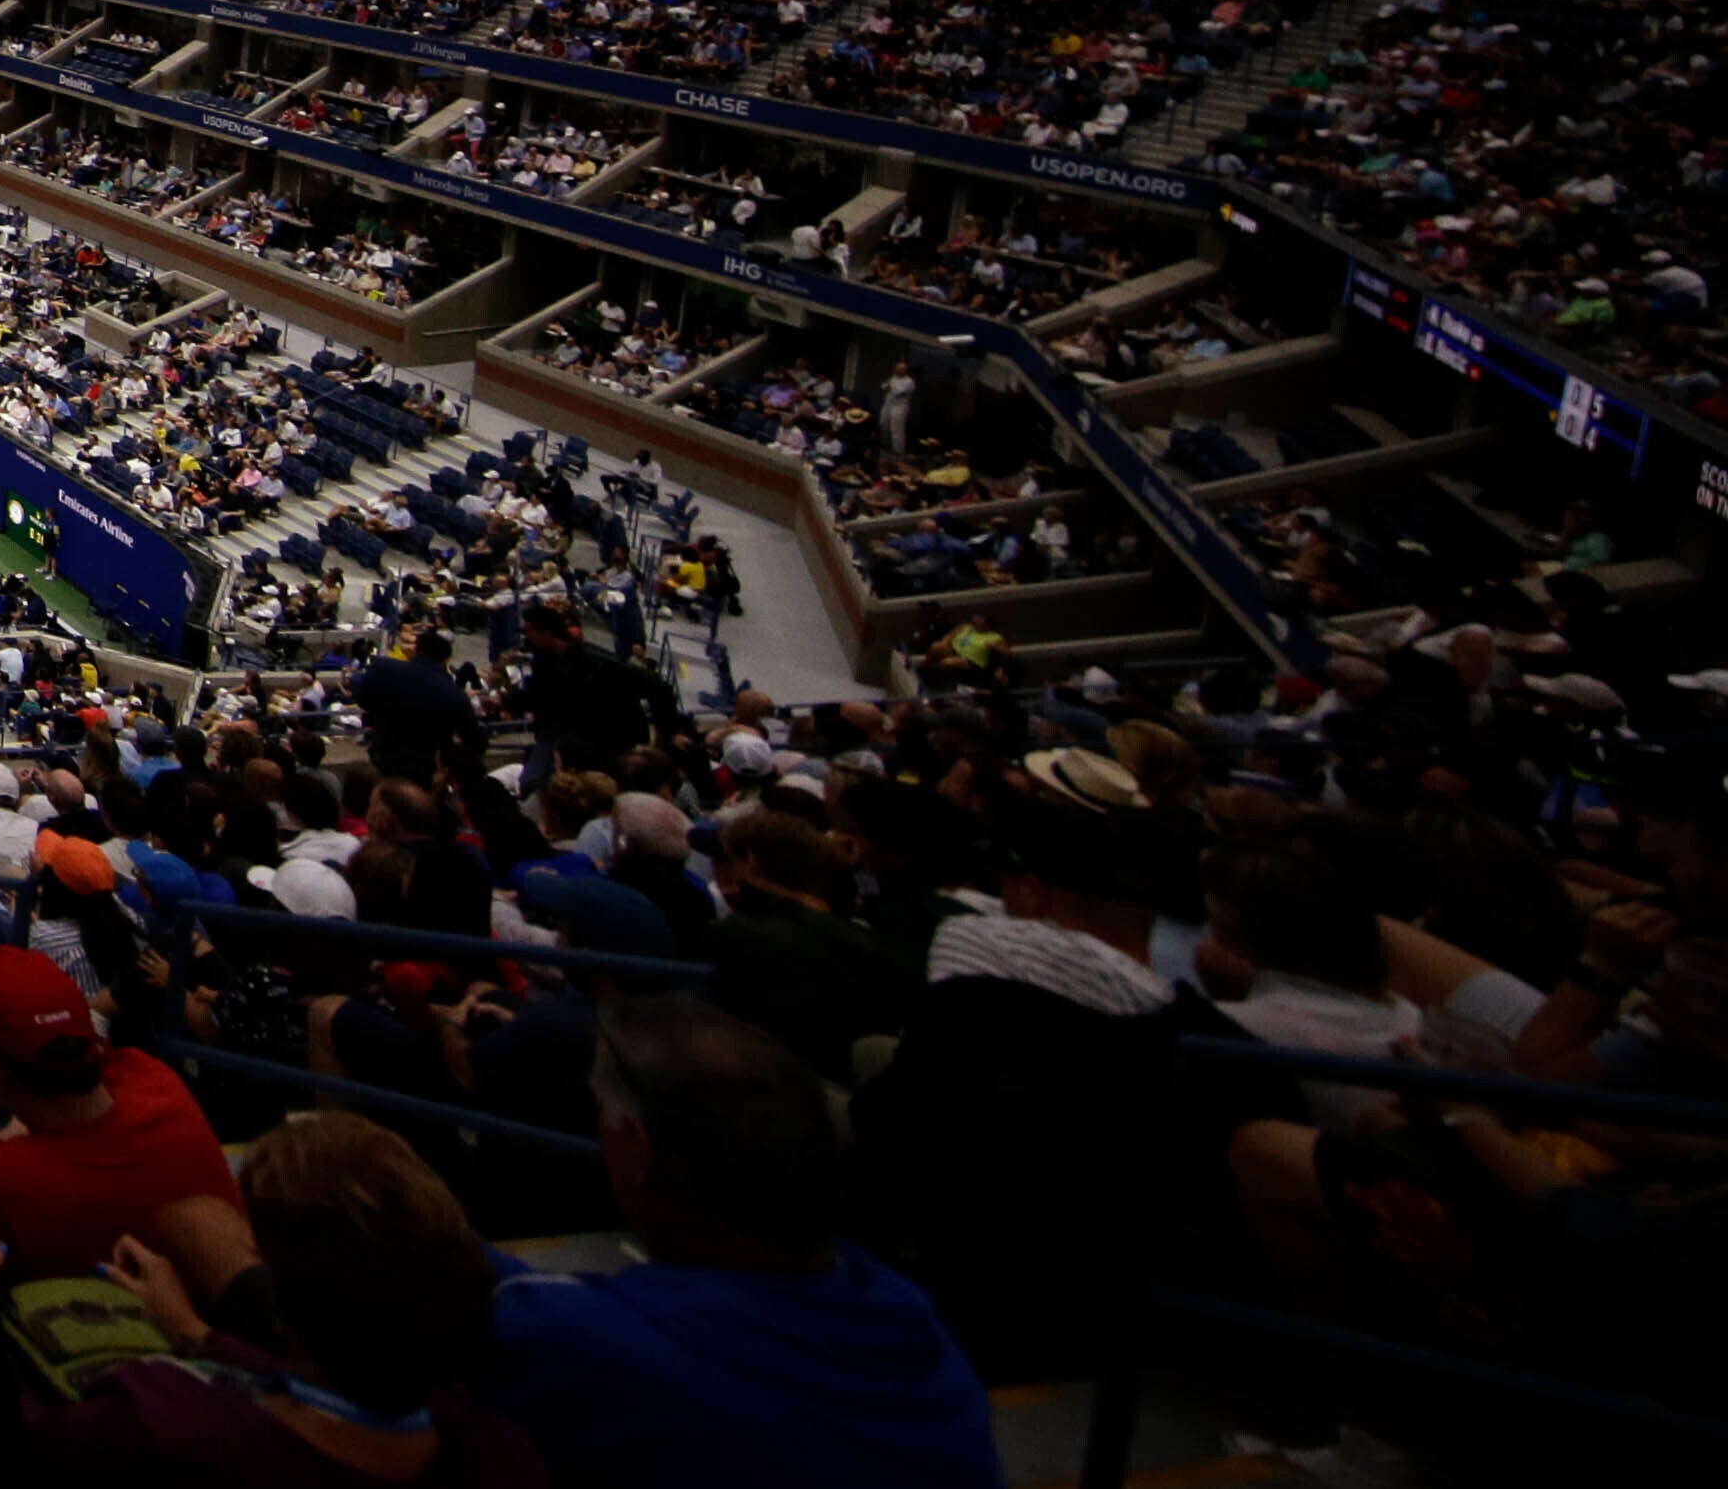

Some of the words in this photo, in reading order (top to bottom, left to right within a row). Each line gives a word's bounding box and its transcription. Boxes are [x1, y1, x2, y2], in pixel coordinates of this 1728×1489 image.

[675, 88, 750, 116] CHASE
[203, 113, 264, 138] USOPEN.ORG
[1030, 154, 1186, 200] USOPEN.ORG
[724, 254, 762, 281] IHG
[1592, 394, 1605, 420] 5
[1585, 426, 1599, 452] 4
[1700, 460, 1728, 494] SCO
[1696, 484, 1713, 510] ON
[58, 488, 99, 525] Emirates
[100, 516, 135, 550] Airline
